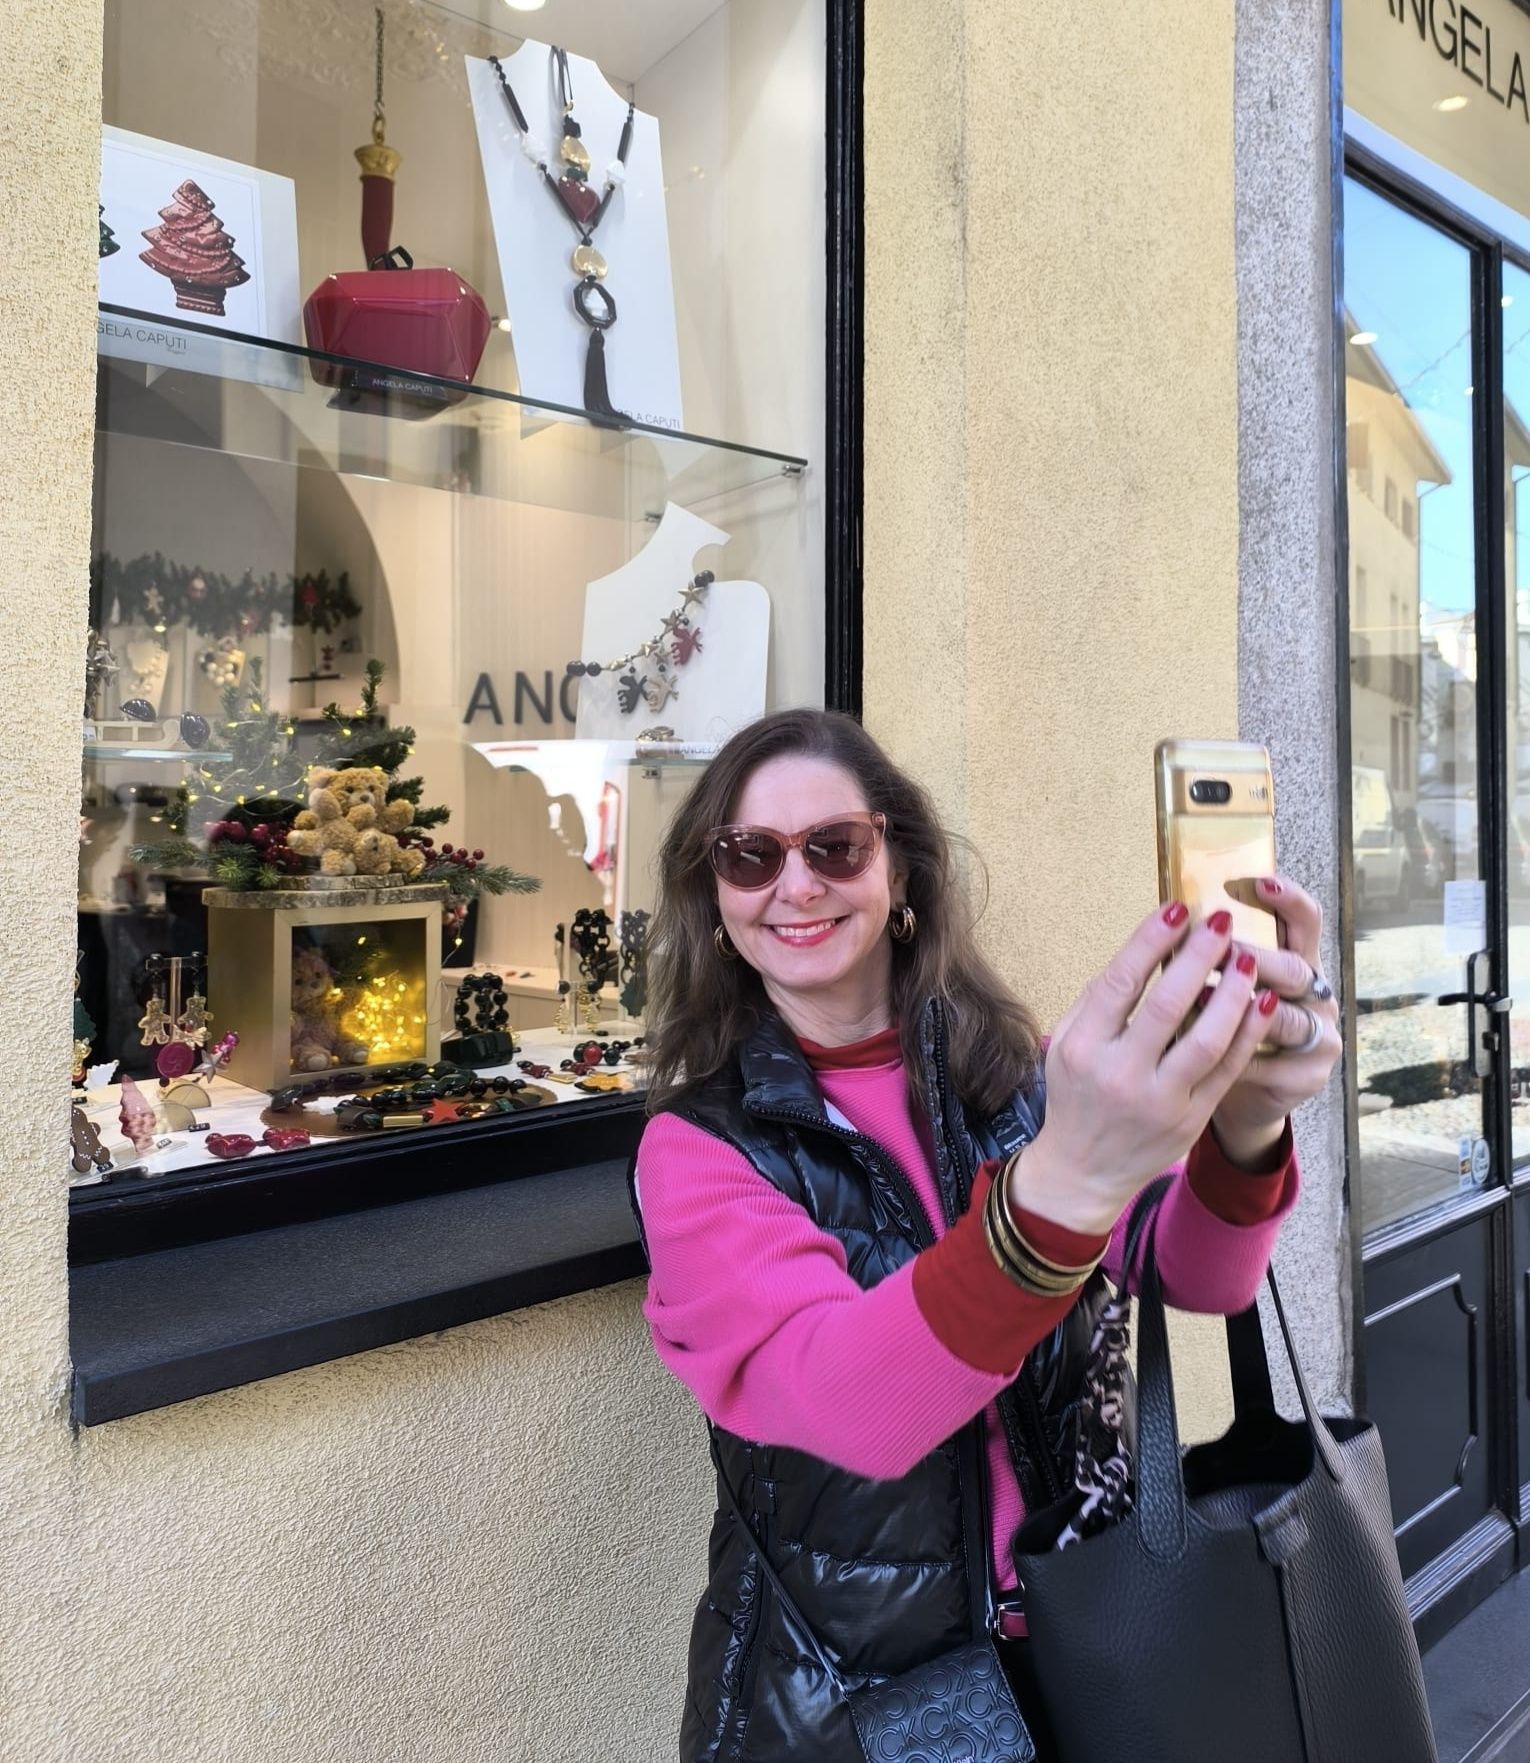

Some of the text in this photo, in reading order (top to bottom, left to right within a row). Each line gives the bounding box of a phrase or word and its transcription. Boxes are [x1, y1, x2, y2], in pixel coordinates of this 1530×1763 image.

[1388, 0, 1530, 124] NGELA
[136, 329, 187, 350] CAPUTI
[645, 414, 680, 430] CAPUTI
